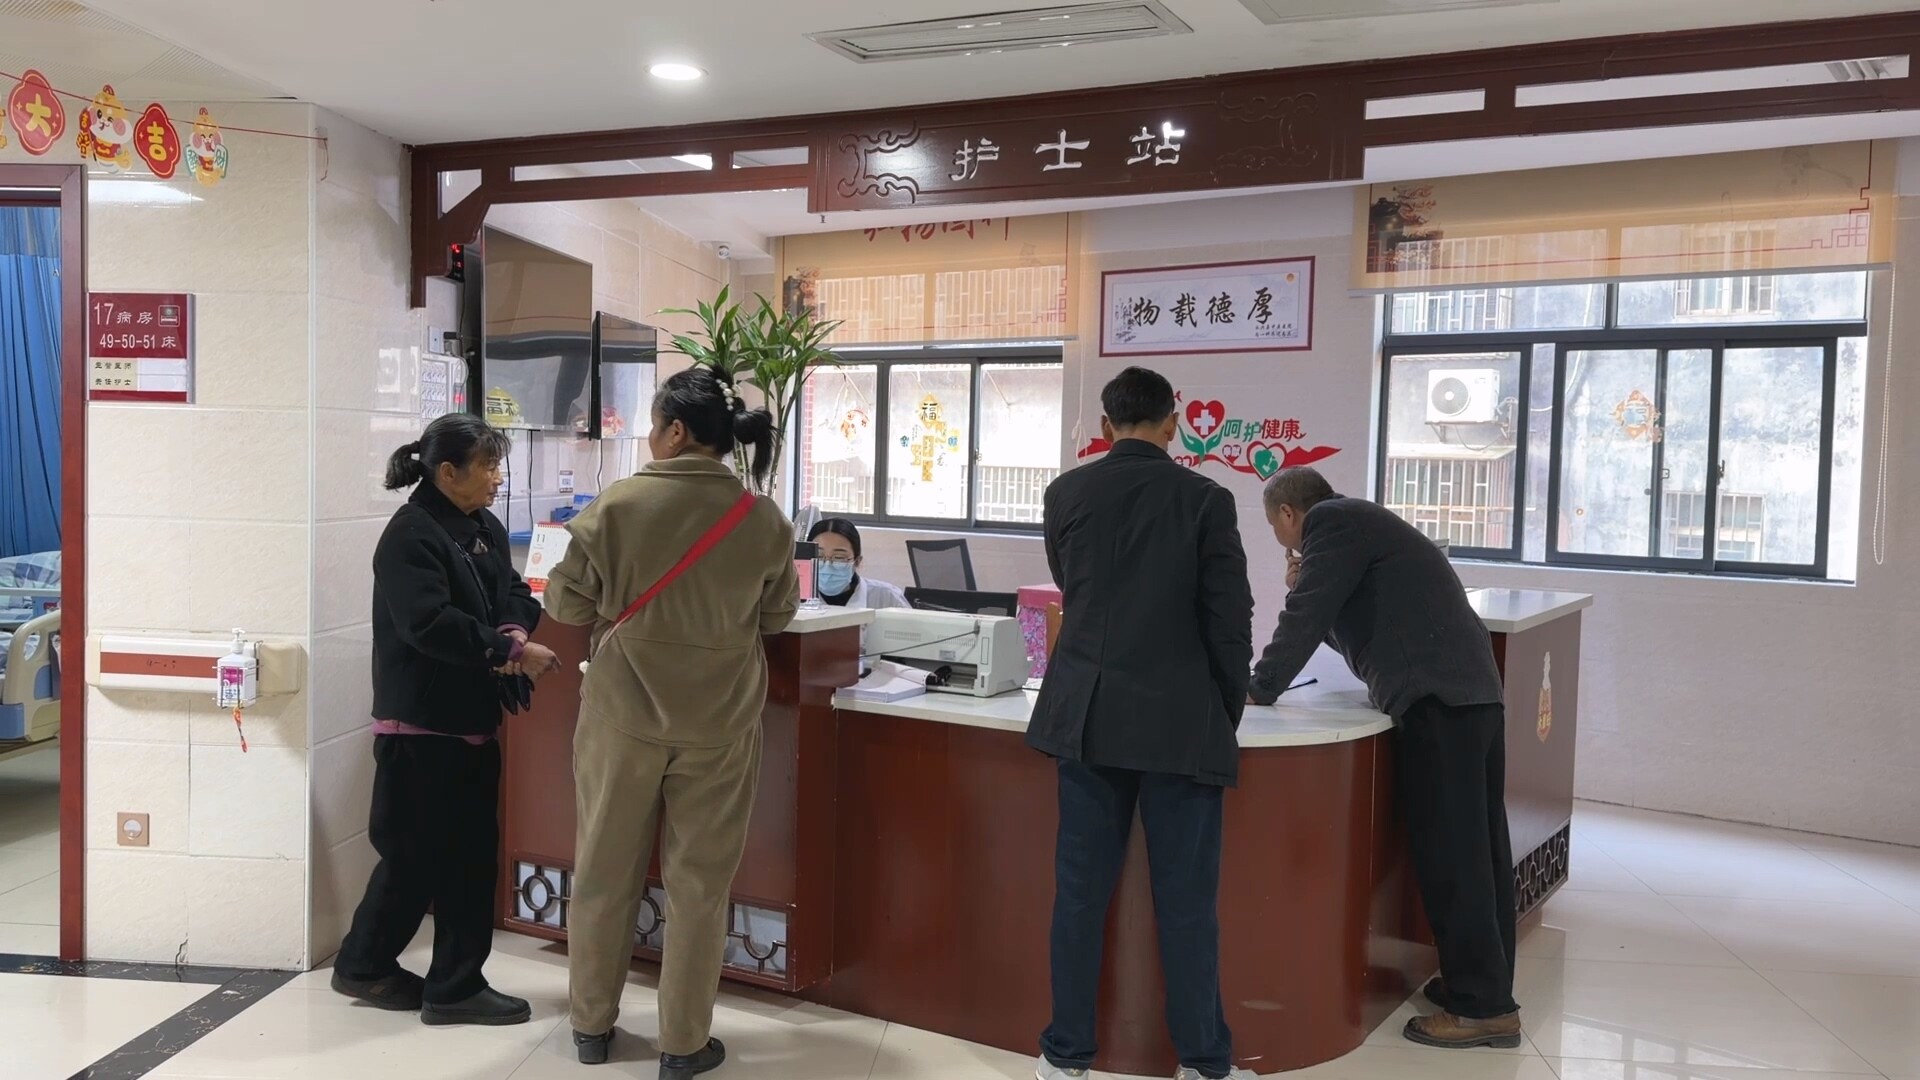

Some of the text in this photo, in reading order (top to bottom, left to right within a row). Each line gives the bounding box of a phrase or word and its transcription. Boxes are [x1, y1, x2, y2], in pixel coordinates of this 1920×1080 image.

[25, 93, 167, 161] 大 吉
[950, 121, 1186, 182] 护士站
[1133, 287, 1273, 327] 厚德载物
[921, 402, 938, 421] 福
[1223, 418, 1307, 442] 呵护健康
